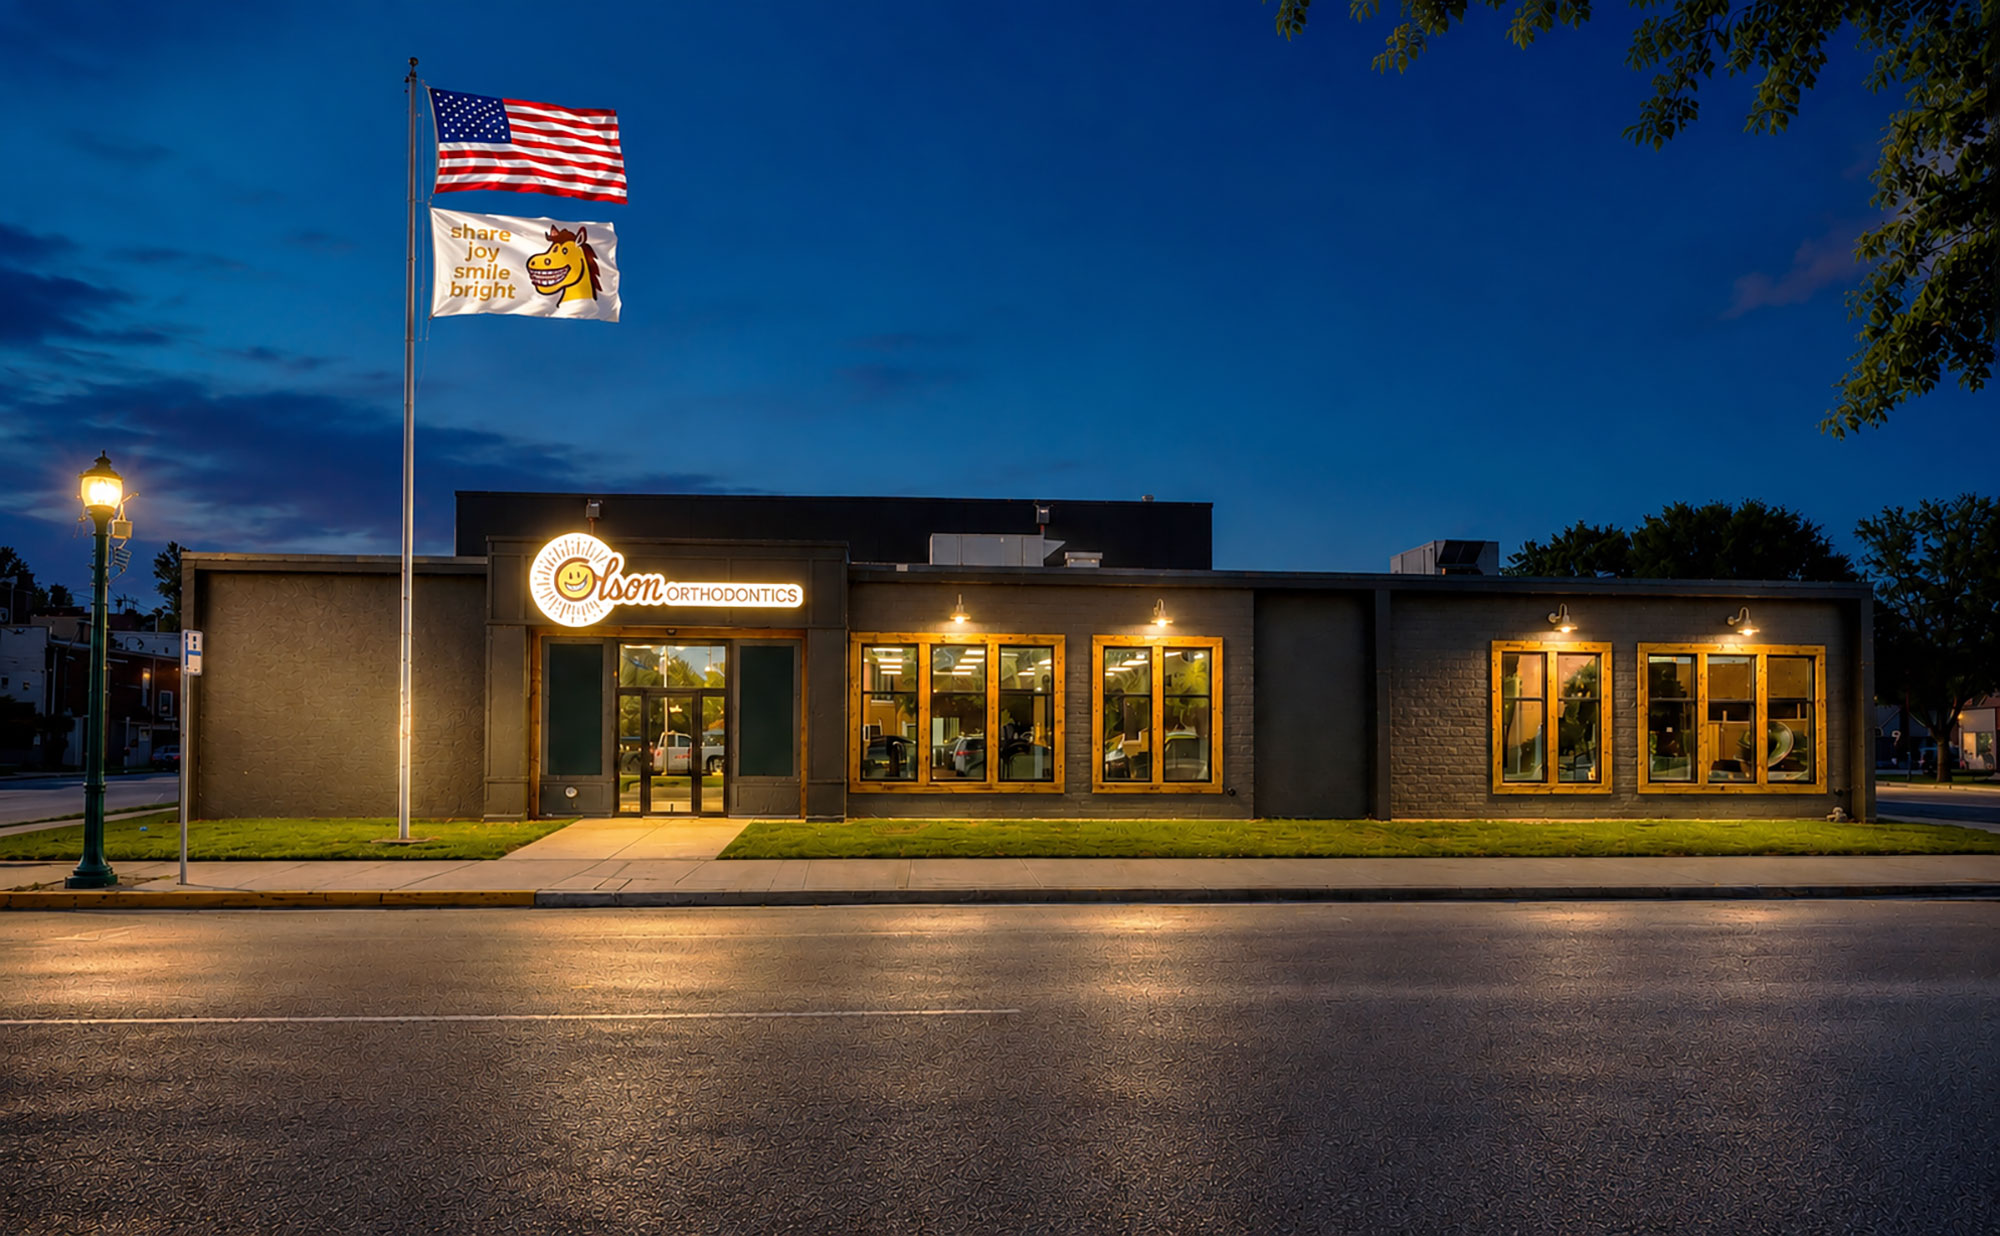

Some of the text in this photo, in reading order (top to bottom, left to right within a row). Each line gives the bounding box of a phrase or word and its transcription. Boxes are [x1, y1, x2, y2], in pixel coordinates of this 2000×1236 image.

[451, 223, 511, 242] share
[465, 242, 500, 263] joy
[454, 264, 511, 280] smile
[450, 281, 516, 301] bright
[554, 557, 798, 602] Olson ORTHODONTICS
